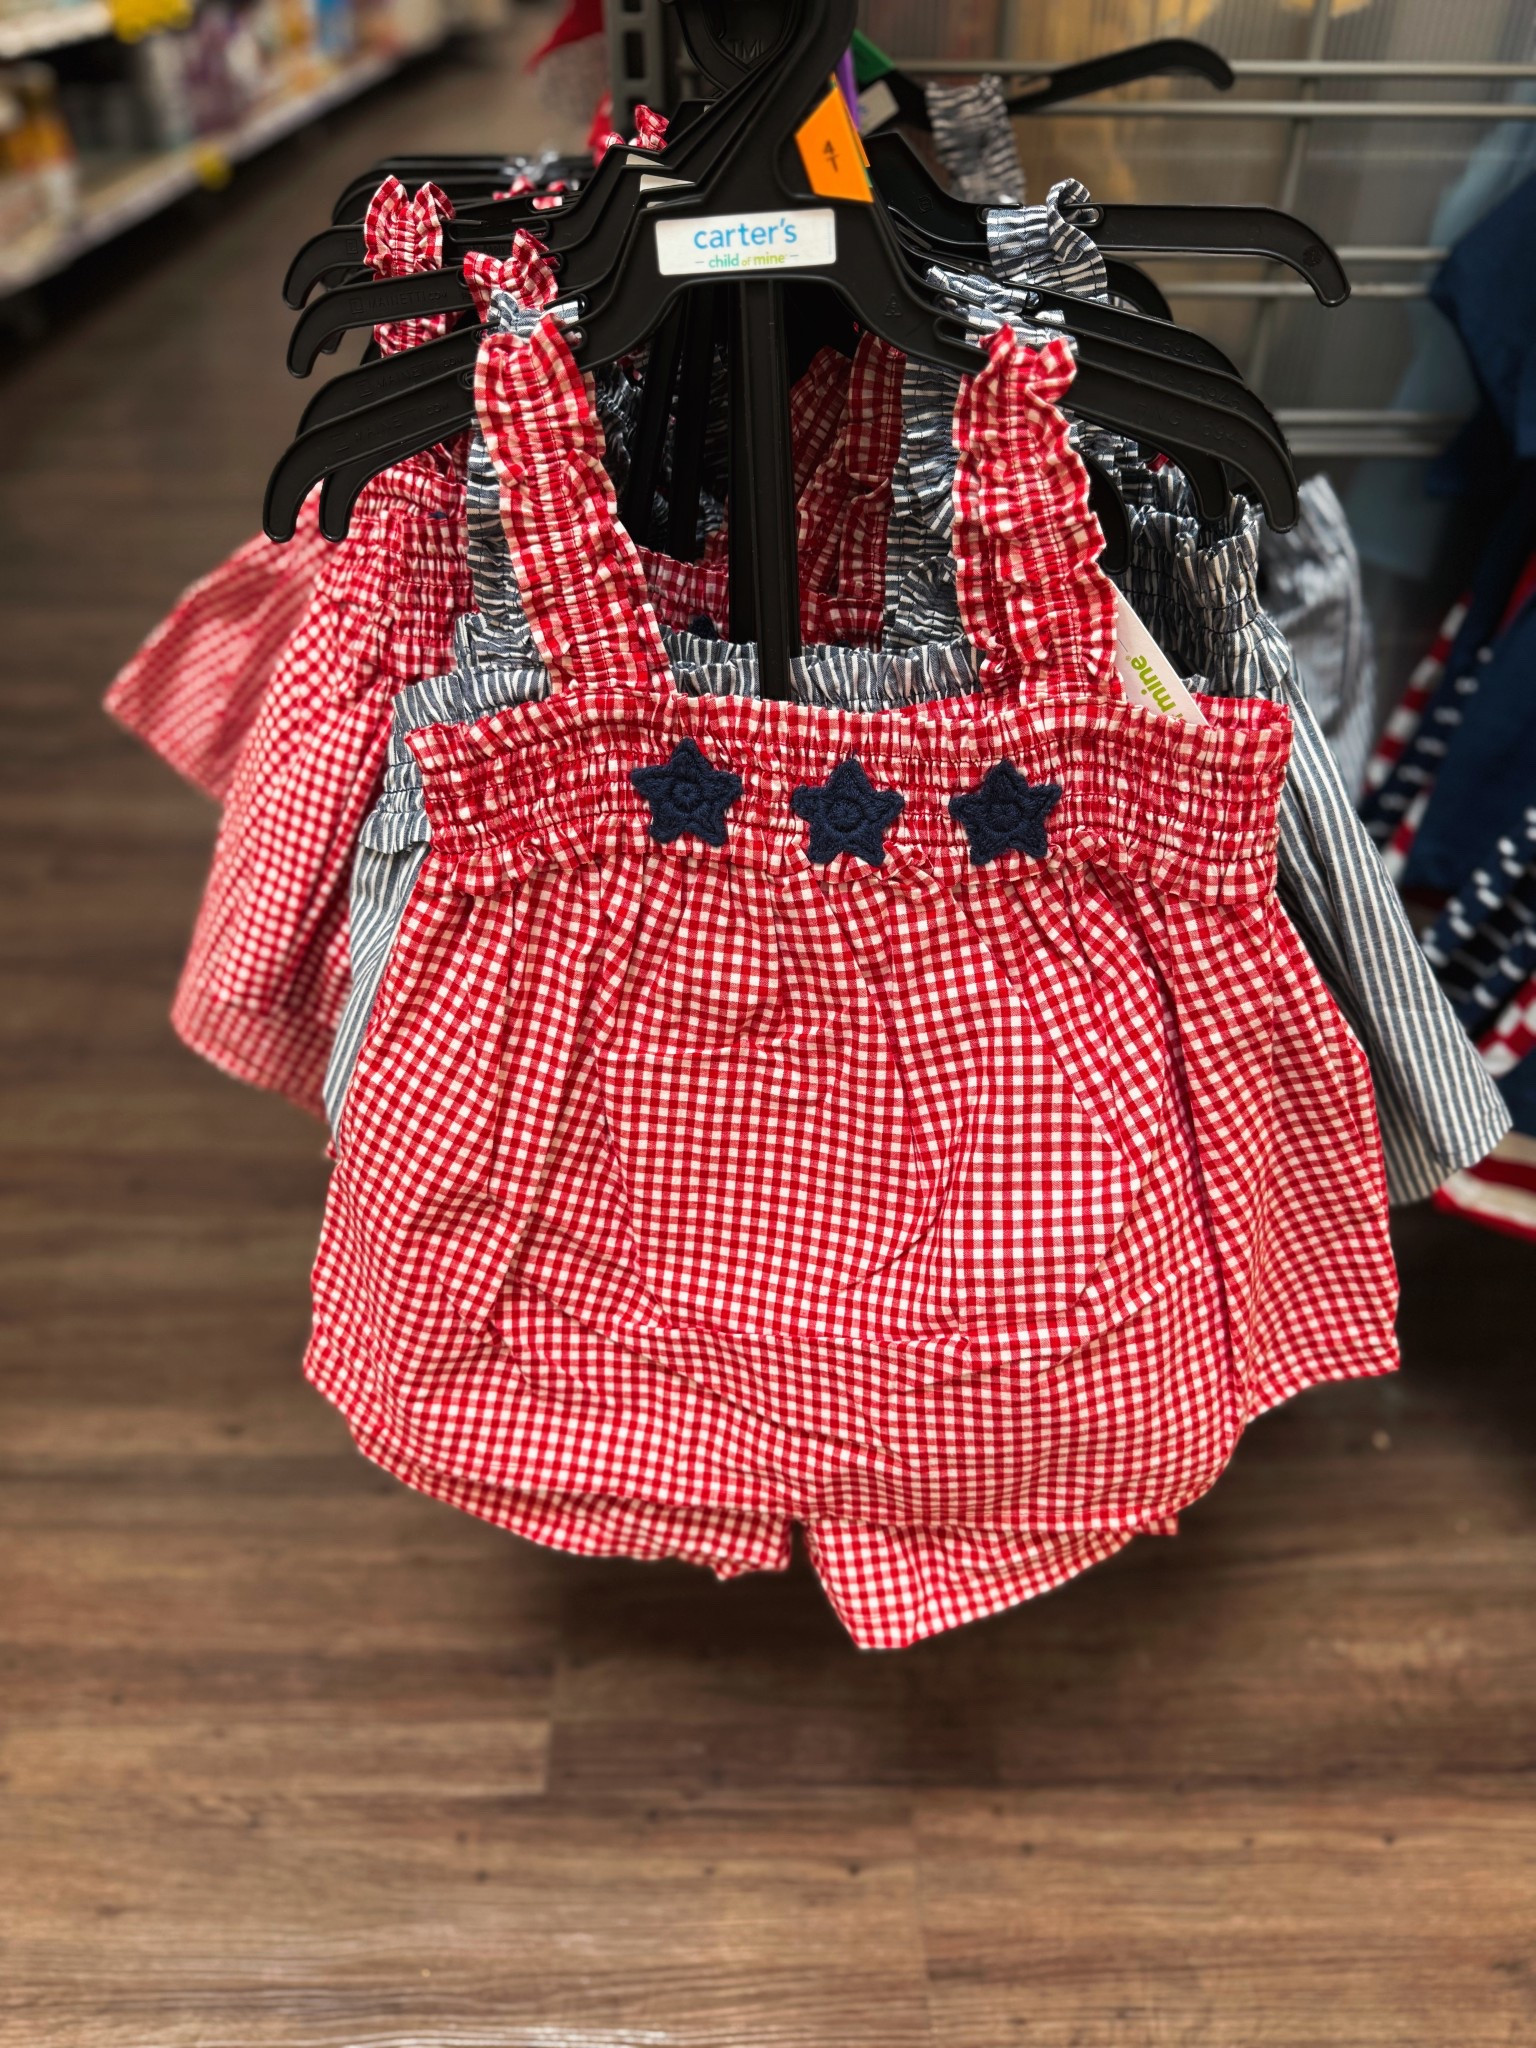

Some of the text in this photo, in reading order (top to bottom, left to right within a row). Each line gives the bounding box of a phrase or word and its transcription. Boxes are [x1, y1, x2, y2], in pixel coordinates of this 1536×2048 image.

[693, 217, 798, 250] carter's
[708, 252, 785, 269] child of mine
[1131, 655, 1177, 713] mine
